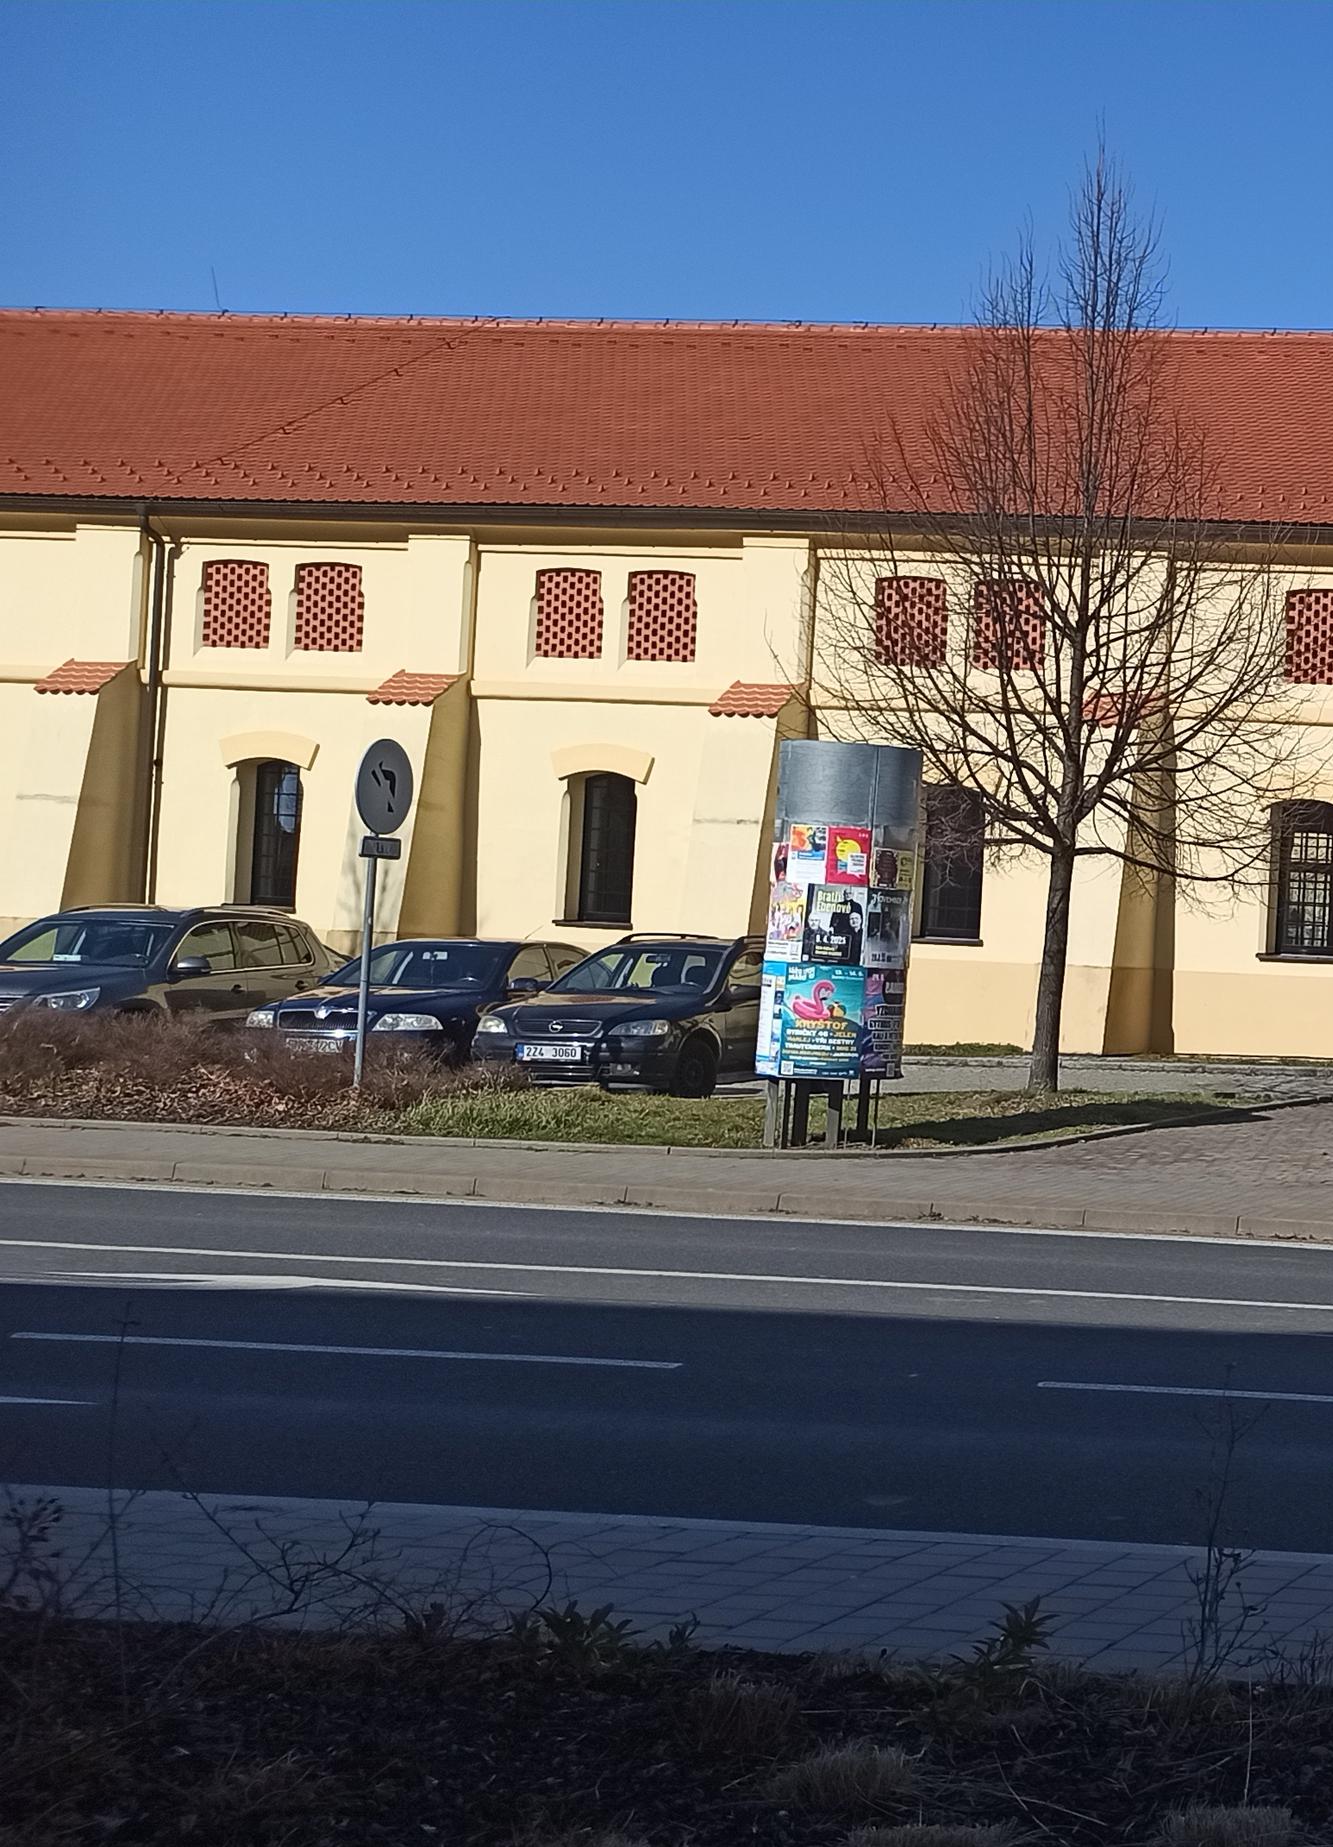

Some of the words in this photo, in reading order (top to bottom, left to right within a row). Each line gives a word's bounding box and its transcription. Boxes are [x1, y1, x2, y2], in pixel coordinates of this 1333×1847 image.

[796, 1019, 848, 1030] KRYŠTOF
[526, 1046, 544, 1057] 2Z4
[552, 1047, 577, 1058] 3060
